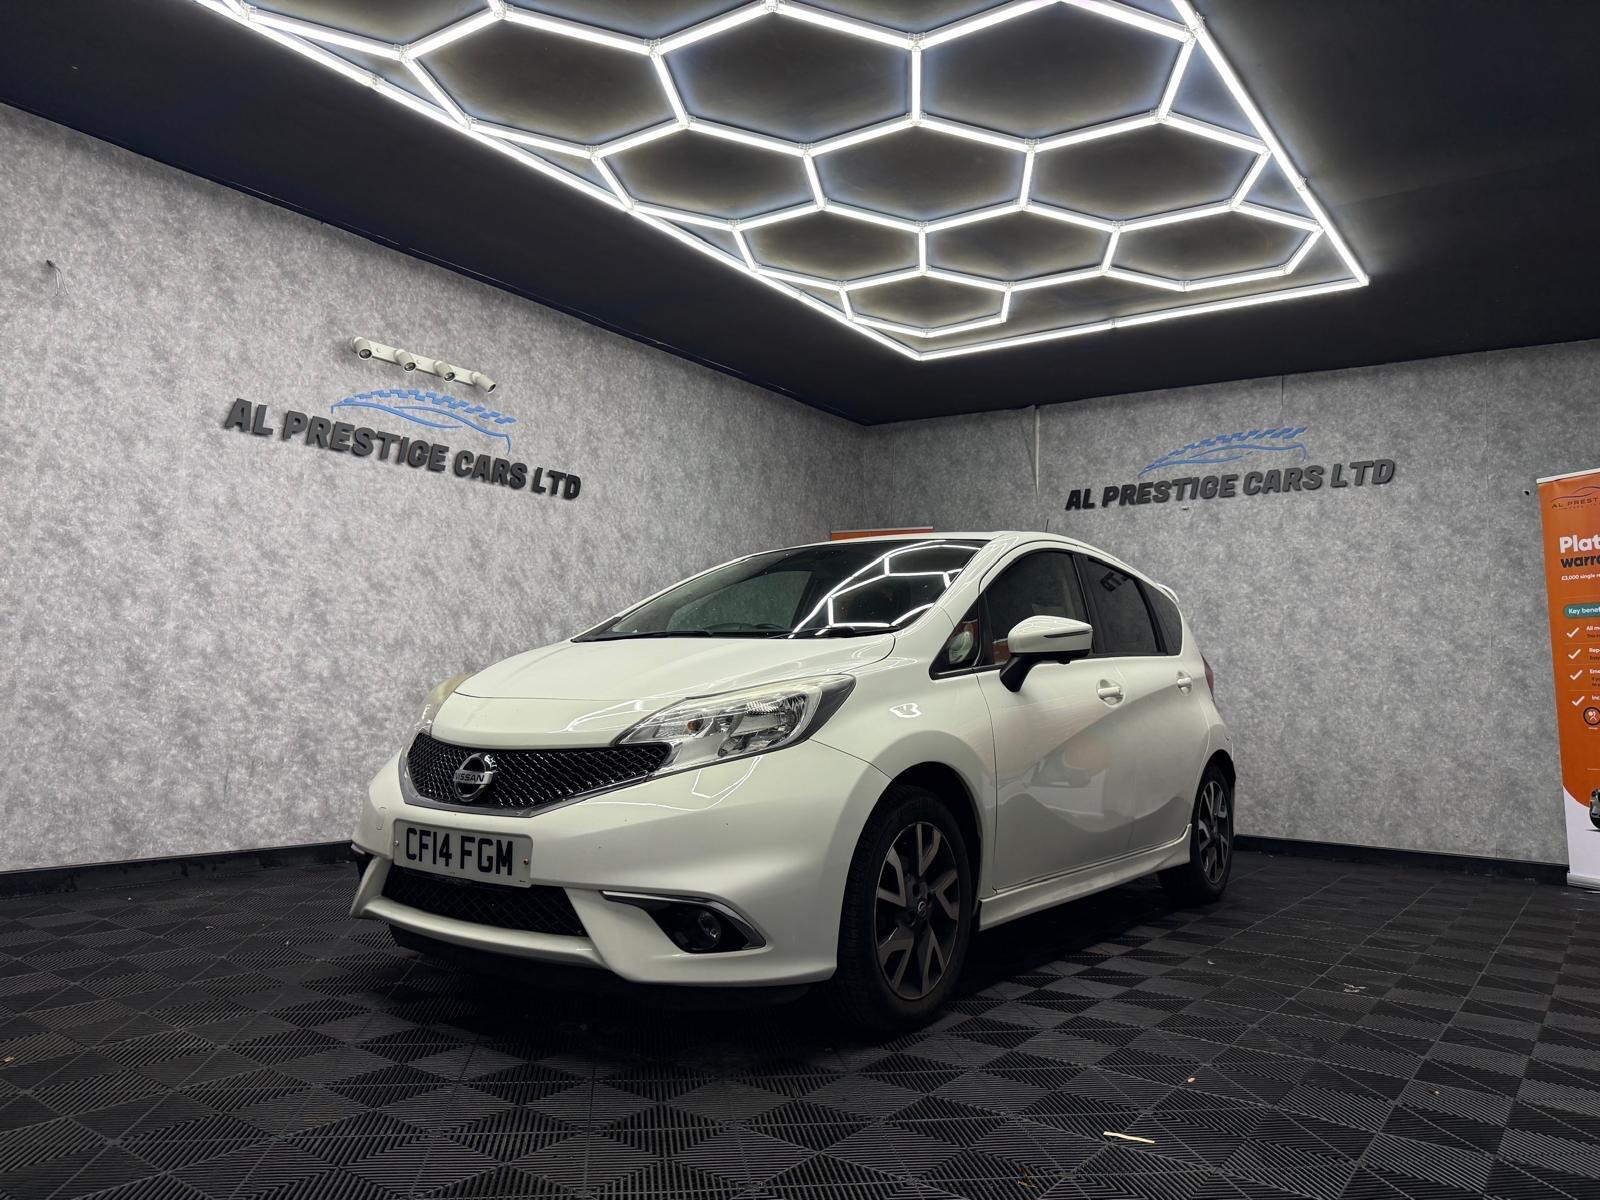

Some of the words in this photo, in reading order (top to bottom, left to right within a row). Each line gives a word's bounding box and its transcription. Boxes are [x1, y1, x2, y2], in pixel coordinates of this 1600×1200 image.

[224, 398, 273, 436] AL
[282, 410, 449, 472] PRESTIGE
[454, 449, 528, 490] CARS
[531, 467, 581, 500] LTD
[1065, 488, 1096, 511] AL
[1101, 474, 1238, 508] PRESTIGE
[1243, 464, 1325, 496] CARS
[1330, 458, 1395, 488] LTD
[406, 827, 453, 867] CF14
[459, 834, 513, 876] FGM
